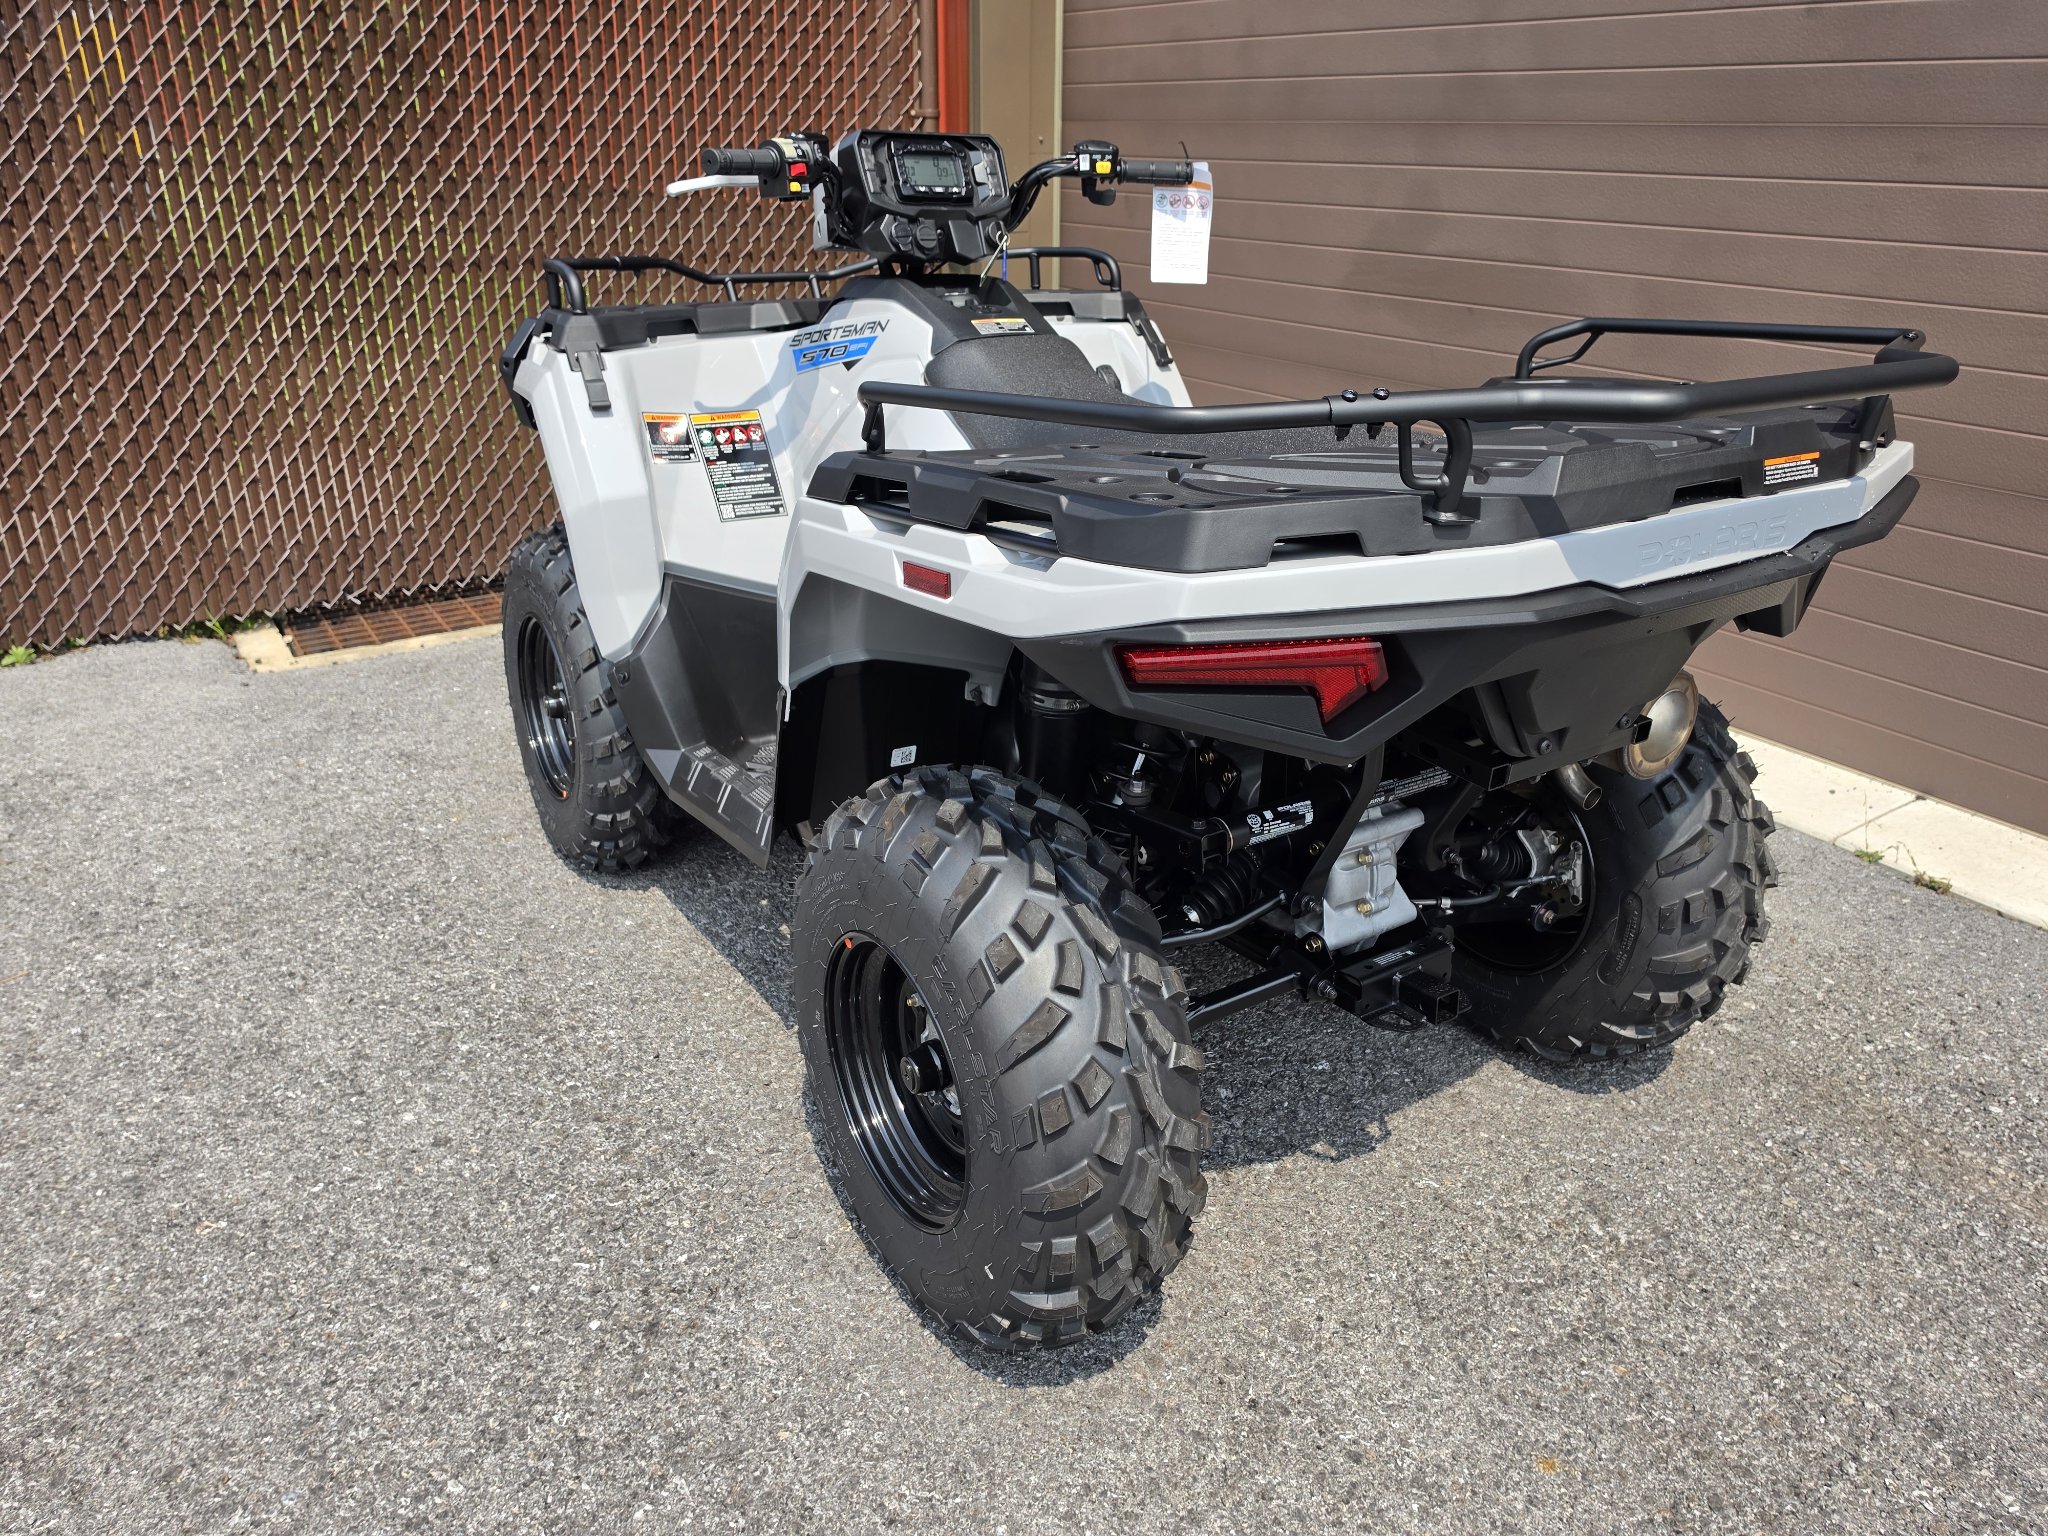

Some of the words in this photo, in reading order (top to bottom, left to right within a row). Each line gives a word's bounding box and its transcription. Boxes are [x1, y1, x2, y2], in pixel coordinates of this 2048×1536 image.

[789, 319, 890, 347] SPORTSMAN
[800, 344, 848, 364] 570
[1639, 515, 1791, 567] POLARIS
